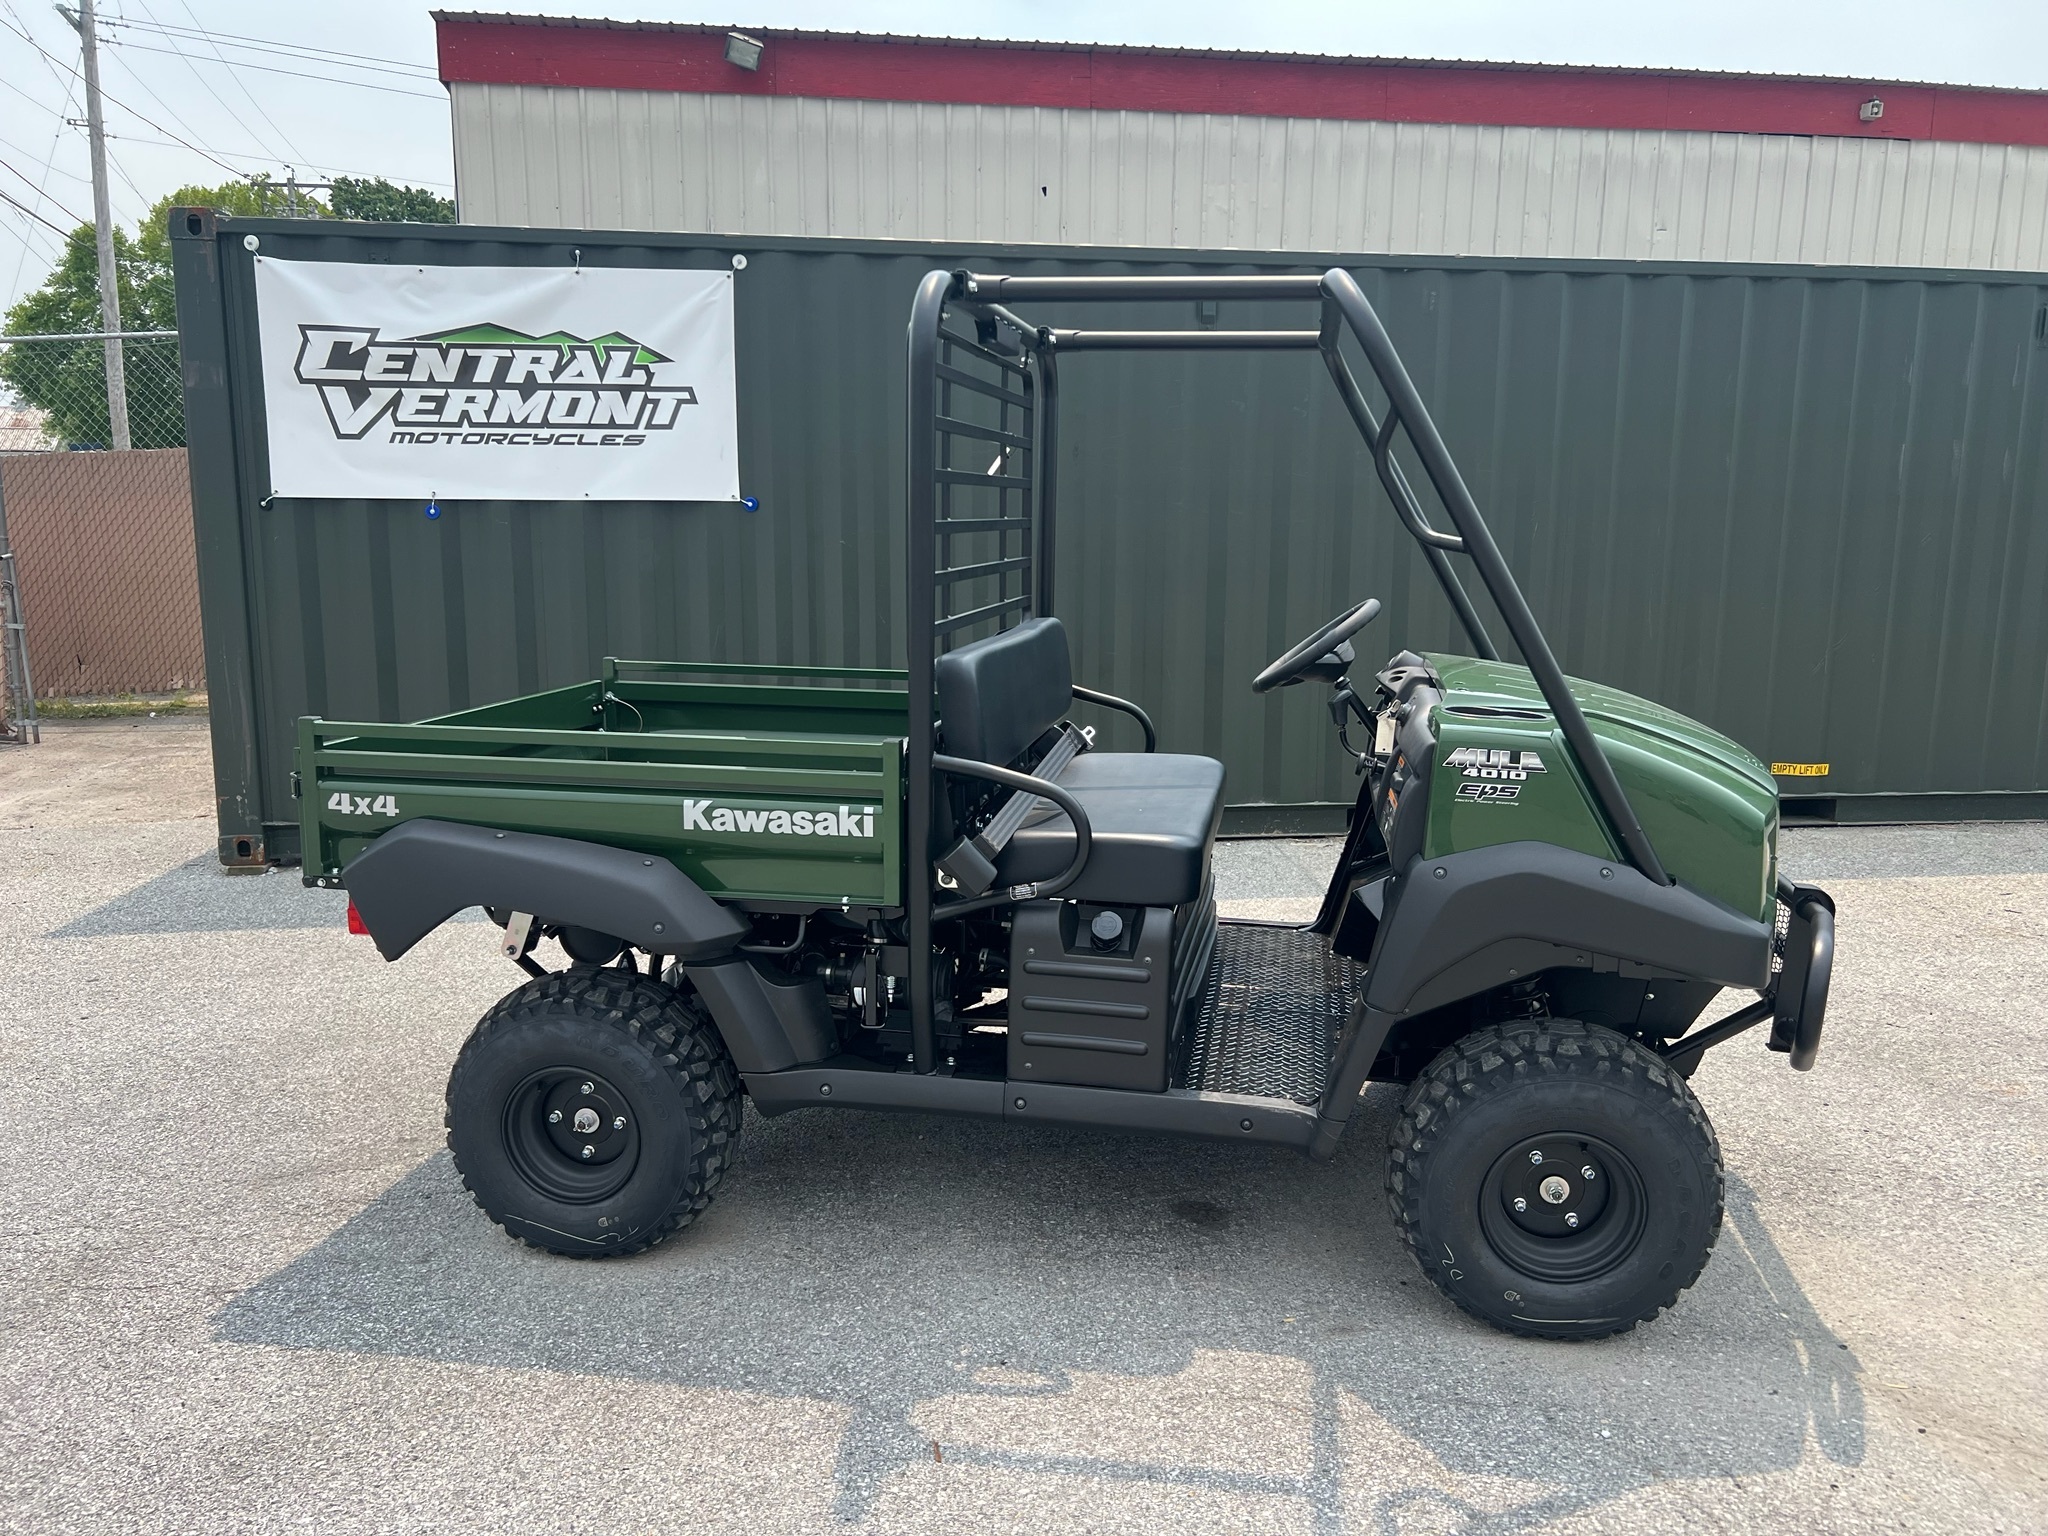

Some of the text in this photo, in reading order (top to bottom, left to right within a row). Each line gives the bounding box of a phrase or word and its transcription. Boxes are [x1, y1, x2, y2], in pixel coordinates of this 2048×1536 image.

[298, 325, 652, 386] CENTRAL
[317, 386, 696, 438] VERMONT
[389, 432, 646, 446] MOTORCYCLES
[1442, 748, 1547, 773] MULE
[1772, 764, 1797, 774] EMPTY
[1799, 765, 1814, 774] LIFT
[1462, 768, 1527, 780] 4010
[1456, 783, 1521, 800] EPS
[328, 793, 400, 817] 4x4
[683, 799, 874, 837] Kawasaki
